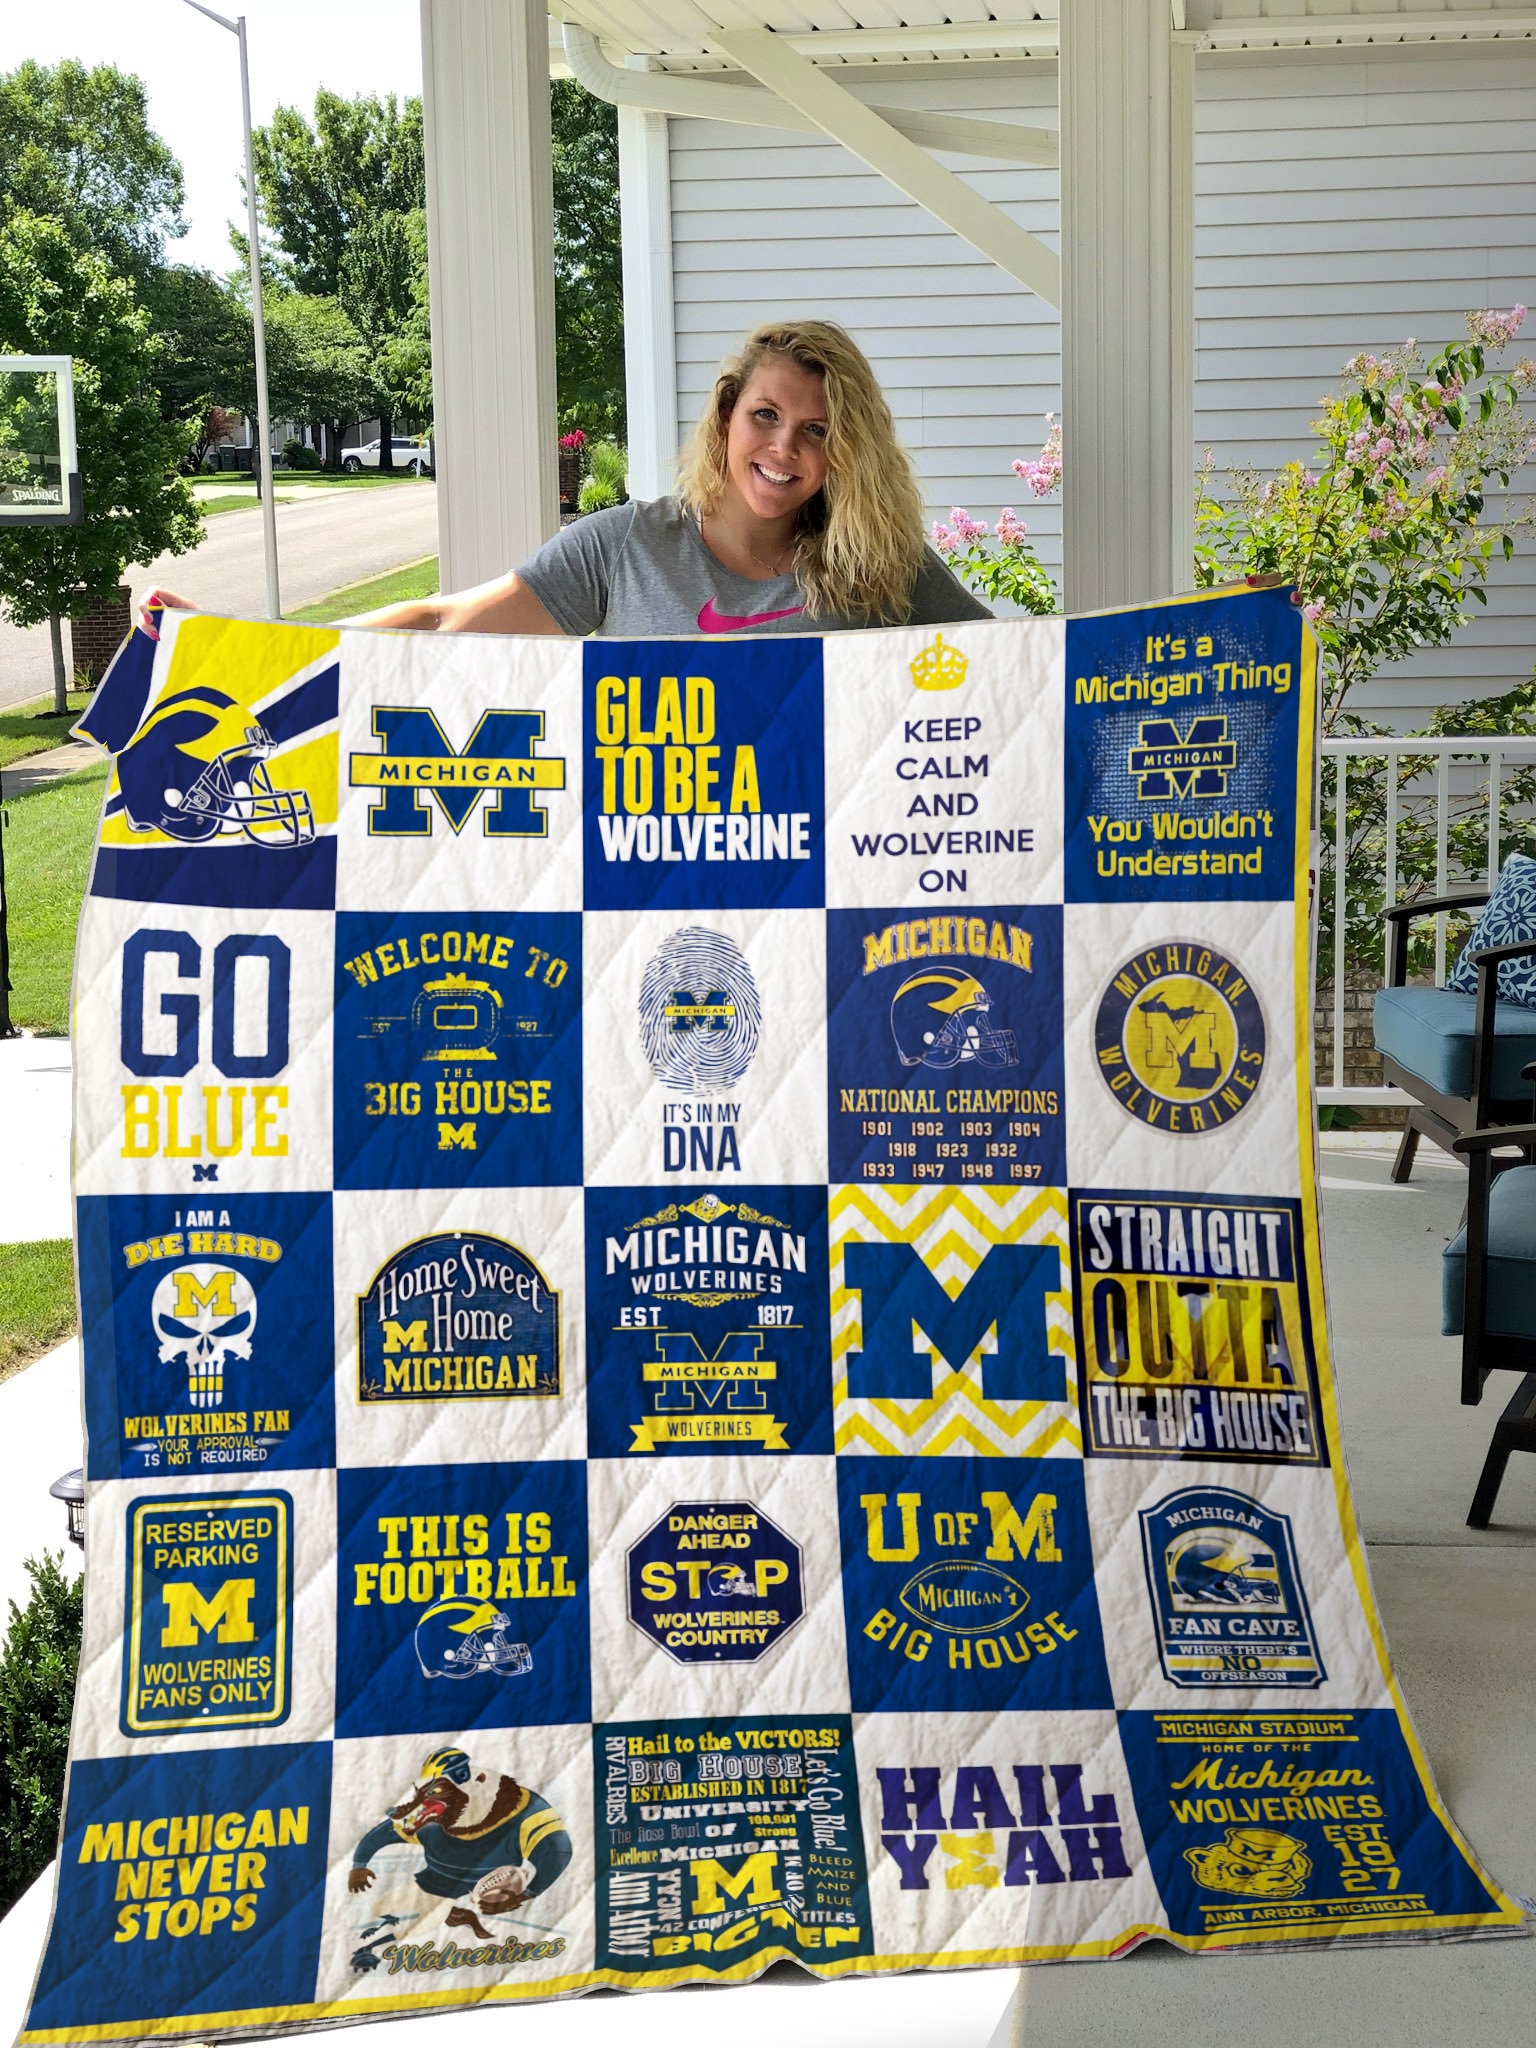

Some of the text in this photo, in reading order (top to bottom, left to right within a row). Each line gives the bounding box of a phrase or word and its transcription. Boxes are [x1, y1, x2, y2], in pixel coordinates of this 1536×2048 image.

[12, 489, 61, 502] SPALDING
[1146, 634, 1213, 664] It's a
[1074, 660, 1292, 705] Michigan Thing
[595, 676, 715, 745] GLAD
[904, 717, 982, 743] KEEP
[378, 763, 536, 782] MICHIGAN
[896, 754, 988, 780] CALM
[1143, 750, 1223, 767] MICHIGAN
[595, 745, 761, 815] TO BE A
[906, 792, 979, 818] AND
[597, 813, 811, 862] WOLVERINE
[1087, 809, 1274, 843] You Wouldn't
[851, 829, 1034, 857] WOLVERINE
[1096, 846, 1262, 877] Understand
[919, 869, 967, 893] ON
[343, 931, 570, 988] WELCOME TO
[862, 915, 1034, 976] MICHIGAN
[1112, 945, 1248, 1001] MICHIGAN
[120, 928, 292, 1079] GO
[673, 1007, 728, 1015] MICHIGAN
[443, 1067, 474, 1079] THE
[364, 1080, 552, 1116] BIG HOUSE
[839, 1088, 1060, 1116] NATIONAL CHAMPIONS
[1098, 1045, 1264, 1131] WOLVERINES
[120, 1084, 289, 1158] BLUE
[663, 1103, 742, 1123] IT'S IN MY
[862, 1121, 1041, 1137] 1901 1902 1903 1904
[663, 1125, 742, 1172] DNA
[888, 1142, 1018, 1158] 1918 1923 1932
[862, 1162, 1043, 1179] 1933 1947 1948 1997
[174, 1210, 232, 1228] I AM A
[123, 1232, 283, 1269] DIE HARD
[605, 1225, 807, 1276] MICHIGAN
[1089, 1204, 1282, 1279] STRAIGHT
[172, 1271, 237, 1318] M
[376, 1244, 544, 1323] Home Sweet
[631, 1270, 782, 1295] WOLVERINES
[432, 1291, 514, 1353] Home
[620, 1305, 795, 1327] EST 1817
[843, 1242, 1068, 1402] M
[382, 1320, 429, 1354] M
[1092, 1277, 1298, 1386] OUTTA
[383, 1354, 539, 1393] MICHIGAN
[660, 1366, 760, 1378] MICHIGAN
[123, 1409, 291, 1440] WOLVERINES FAN
[667, 1421, 753, 1437] WOLVERINES
[1091, 1384, 1312, 1454] THE BIG HOUSE
[144, 1448, 268, 1467] IS NOT REQUIRED
[156, 1435, 258, 1452] YOUR APPROVAL
[145, 1517, 273, 1545] RESERVED
[668, 1514, 758, 1532] DANGER
[860, 1491, 1063, 1562] U OF M
[1165, 1506, 1264, 1531] MICHIGAN
[378, 1512, 551, 1559] THIS IS
[677, 1533, 751, 1550] AHEAD
[154, 1543, 260, 1570] PARKING
[353, 1556, 577, 1606] FOOTBALL
[653, 1610, 780, 1629] WOLVERINES
[1168, 1617, 1301, 1637] FAN CAVE
[666, 1628, 769, 1648] COUNTRY
[862, 1607, 1079, 1669] BIG HOUSE
[1178, 1644, 1298, 1655] WHERE THERE'S
[143, 1656, 272, 1686] WOLVERINES
[1201, 1671, 1287, 1681] OFFSEASON
[1219, 1655, 1262, 1671] NO
[139, 1680, 273, 1710] FANS ONLY
[627, 1728, 841, 1756] Hail to the VICTORS!
[1161, 1722, 1345, 1736] MICHIGAN STADIUM
[1202, 1743, 1312, 1753] HOME OF THE
[605, 1736, 628, 1826] RIVALRIES
[627, 1757, 682, 1786] BIG
[1170, 1758, 1372, 1796] Michigan
[630, 1778, 808, 1804] ESTABLISHED IN 1817
[803, 1748, 848, 1852] Let's Go Blue!
[876, 1763, 1120, 1831] HAIL
[1168, 1794, 1384, 1824] WOLVERINES
[77, 1806, 310, 1864] MICHIGAN
[704, 1822, 738, 1838] OF
[1322, 1824, 1389, 1843] EST.
[807, 1866, 856, 1880] MAIZE
[809, 1853, 853, 1867] BLEED
[114, 1851, 267, 1902] NEVER
[689, 1851, 783, 1915] M
[816, 1881, 850, 1892] AND
[657, 1867, 682, 1922] NCAA
[817, 1893, 853, 1906] BLUE
[114, 1893, 258, 1943] STOPS
[801, 1910, 856, 1924] TITLES
[1204, 1900, 1428, 1925] ANN ARBOR, MICHIGAN
[652, 1907, 861, 1957] BIG TEN
[382, 1936, 566, 1975] Wolverines
